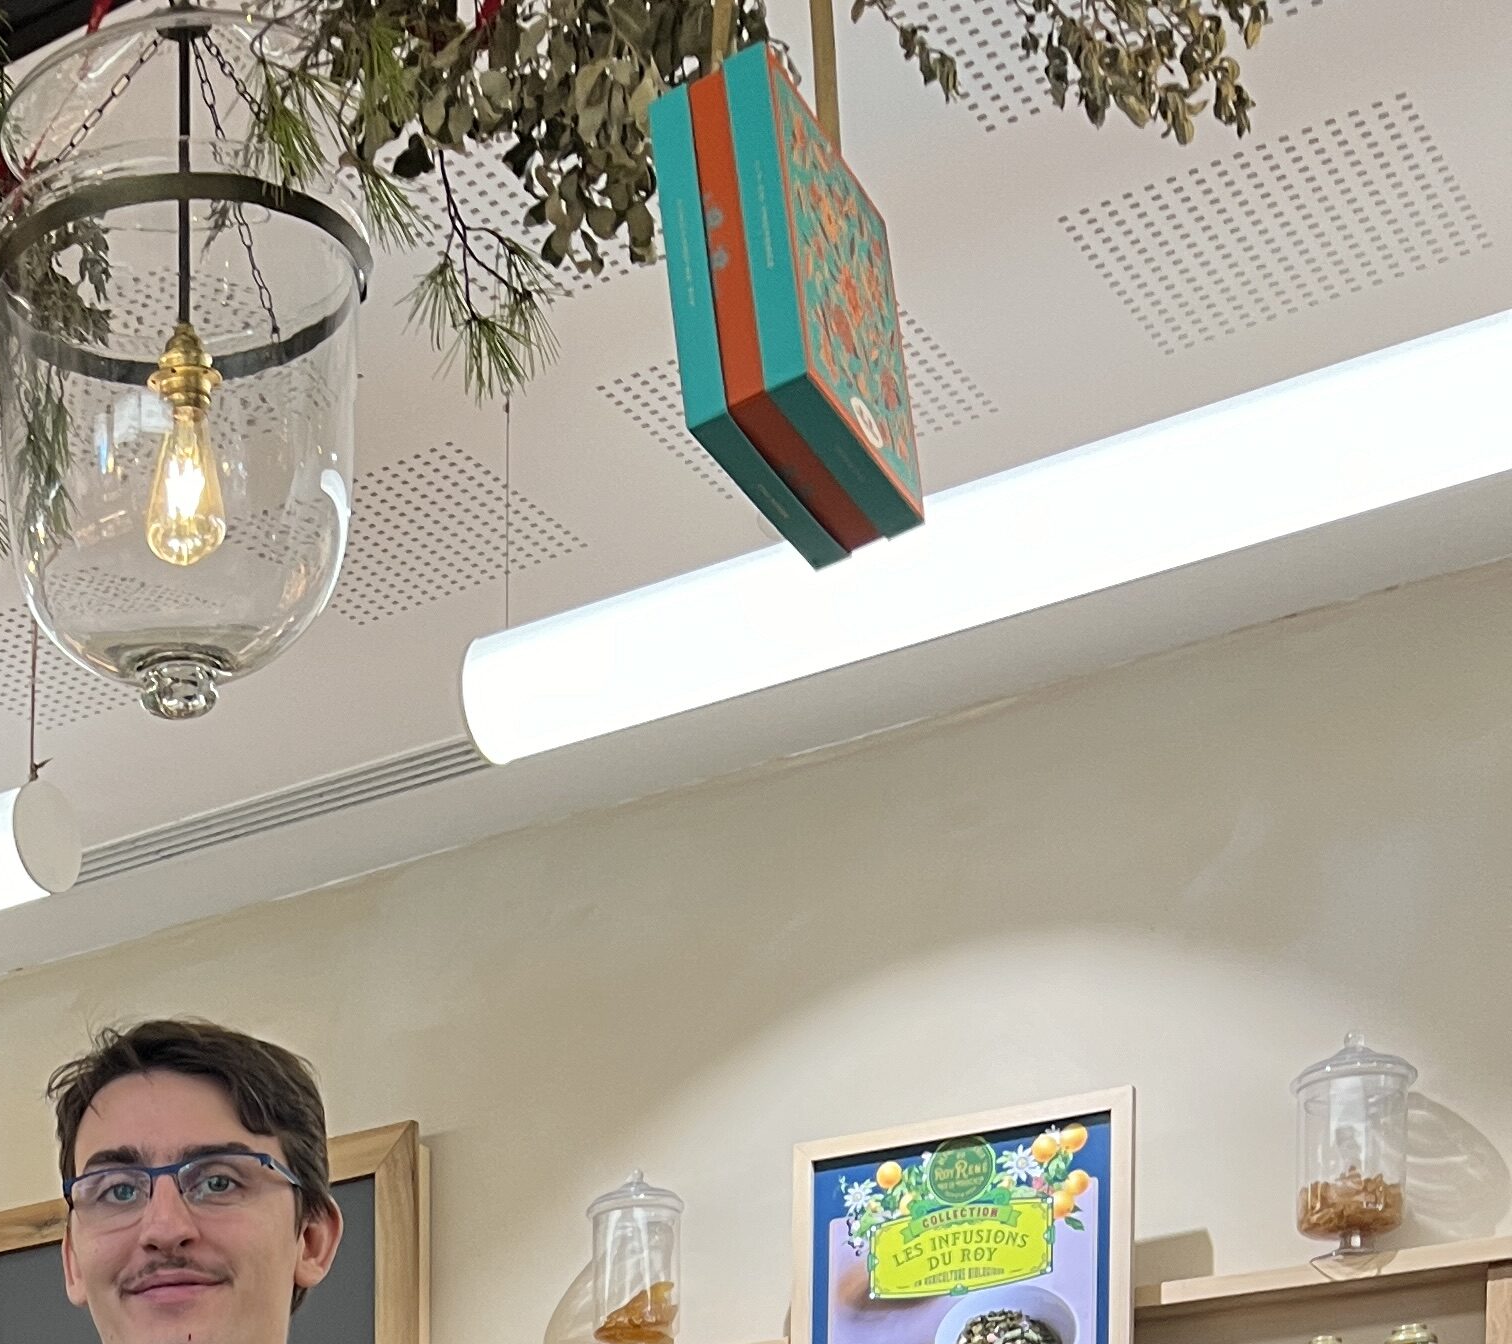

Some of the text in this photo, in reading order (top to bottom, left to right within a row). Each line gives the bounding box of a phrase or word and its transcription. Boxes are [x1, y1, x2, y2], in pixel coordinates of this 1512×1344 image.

[921, 1207, 999, 1229] COLLECTION
[892, 1228, 1030, 1268] LES INFUSIONS
[926, 1246, 999, 1271] DU ROY
